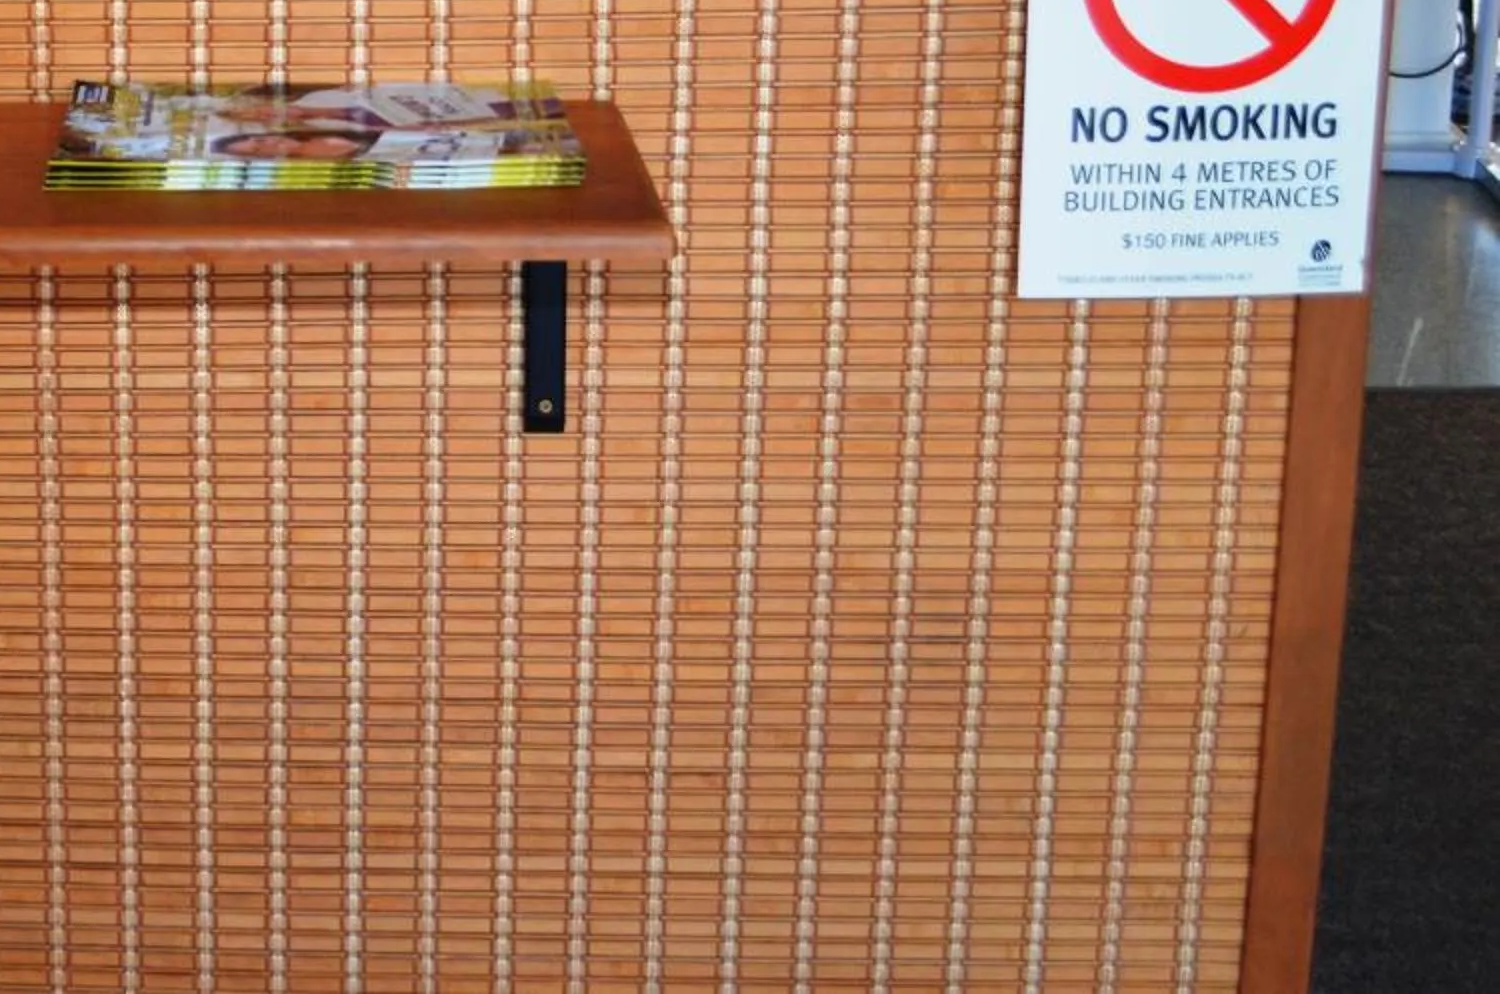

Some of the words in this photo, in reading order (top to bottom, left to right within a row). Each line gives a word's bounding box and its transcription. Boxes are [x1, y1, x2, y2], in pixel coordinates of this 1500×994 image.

[1070, 105, 1129, 144] NO
[1145, 102, 1339, 144] SMOKING
[1071, 162, 1162, 187] WITHIN
[1171, 161, 1188, 185] 4
[1196, 159, 1297, 184] METRES
[1304, 158, 1338, 182] OF
[1064, 189, 1186, 212] BUILDING
[1194, 185, 1340, 211] ENTRANCES
[1121, 232, 1167, 250] $150
[1171, 231, 1207, 248] FINE
[1211, 229, 1280, 248] APPLIES
